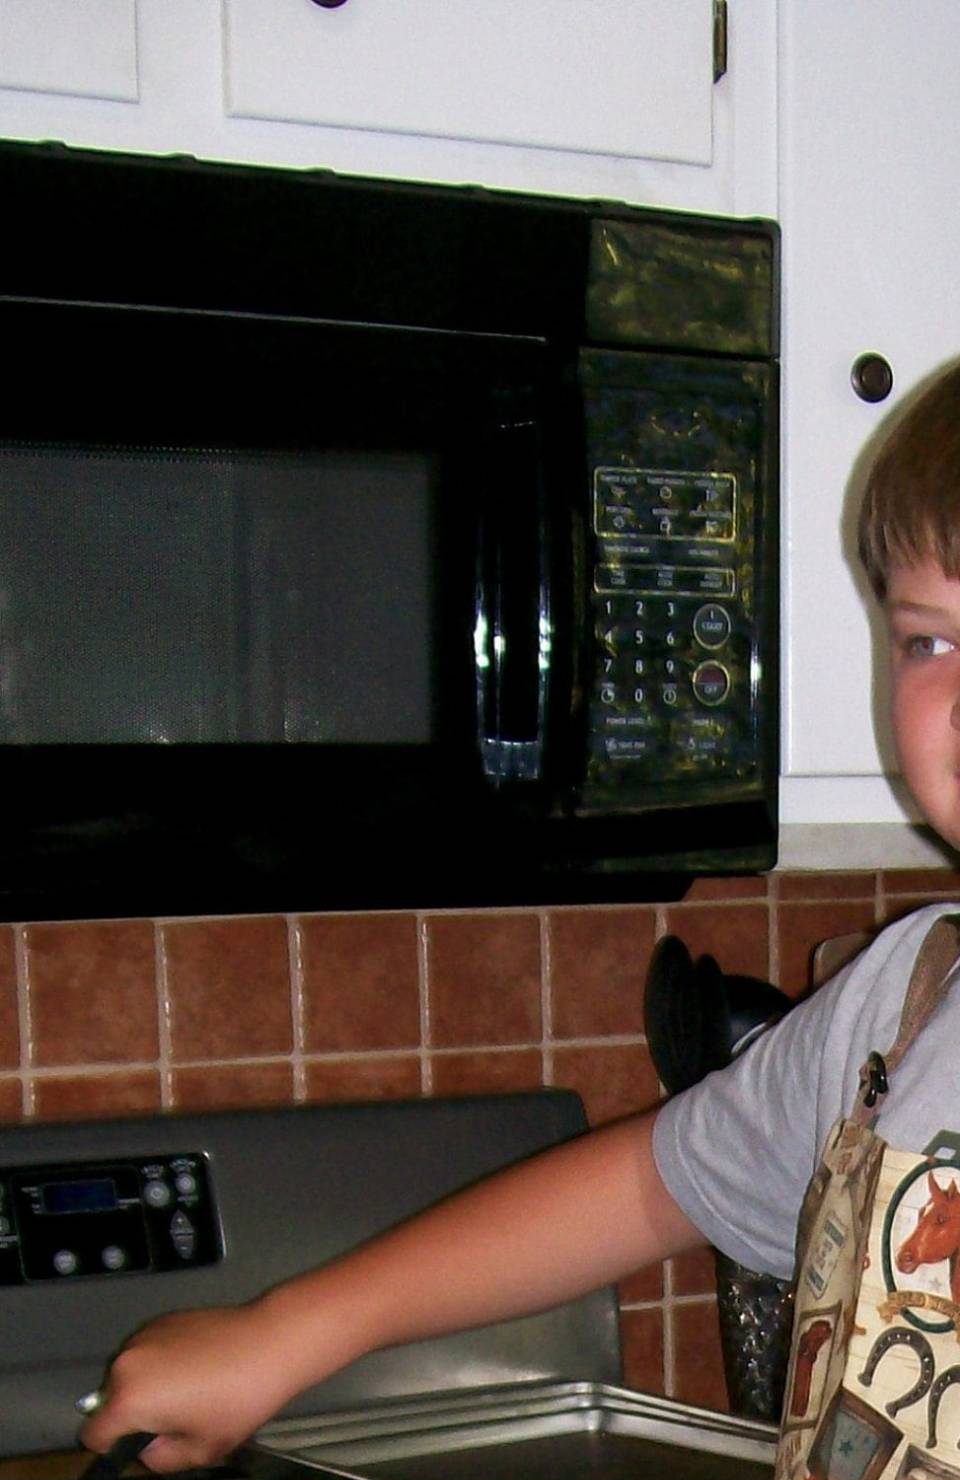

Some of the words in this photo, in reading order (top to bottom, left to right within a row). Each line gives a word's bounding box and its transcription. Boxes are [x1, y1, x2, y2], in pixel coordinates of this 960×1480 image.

[605, 600, 612, 615] 1
[635, 601, 644, 616] 2
[667, 602, 675, 617] 3
[635, 630, 644, 645] 5
[666, 631, 675, 646] 6
[603, 658, 613, 674] 7
[635, 659, 644, 675] 8
[665, 659, 675, 674] 9
[634, 688, 644, 703] 0
